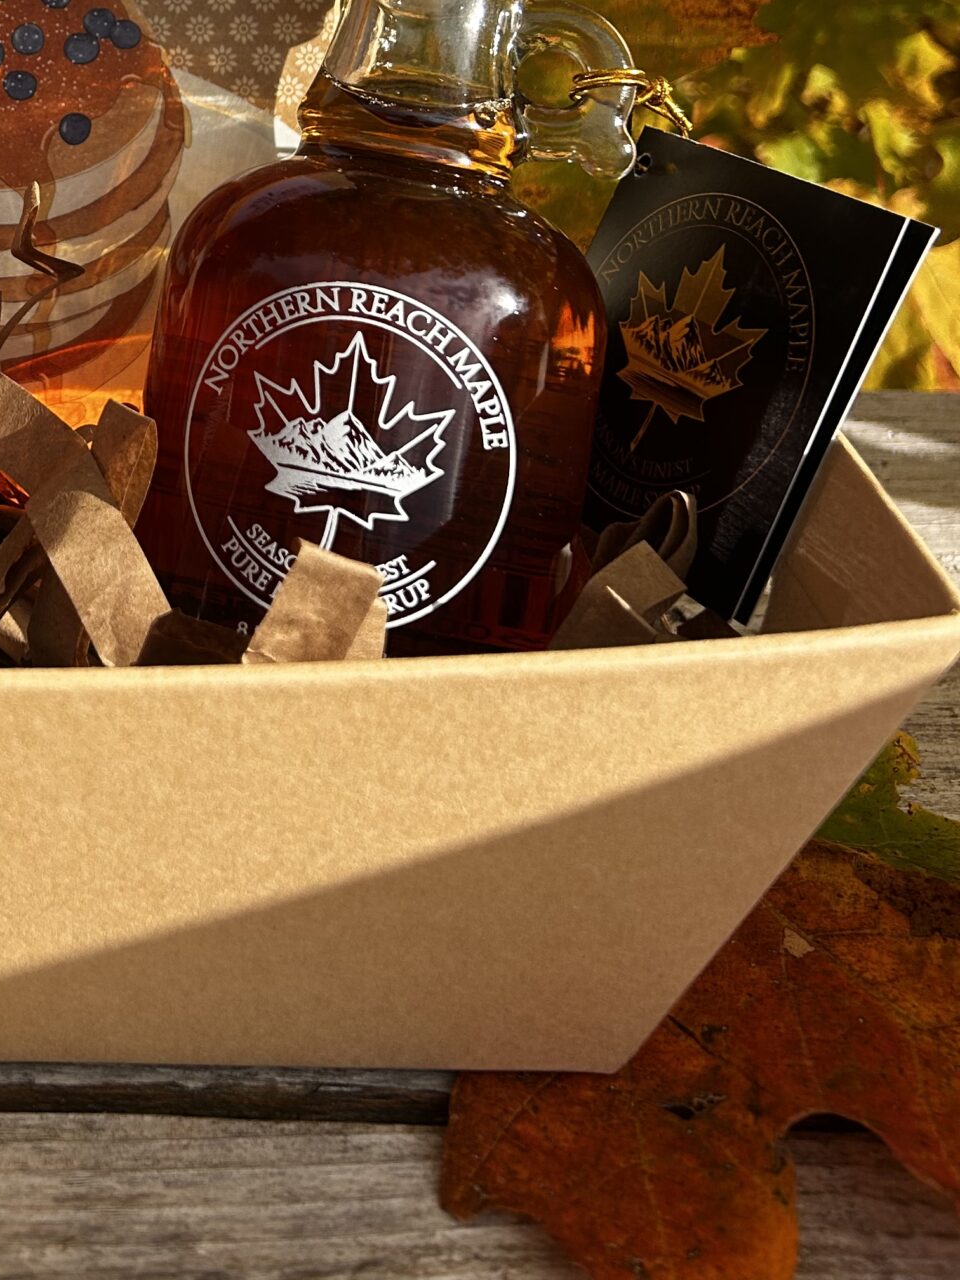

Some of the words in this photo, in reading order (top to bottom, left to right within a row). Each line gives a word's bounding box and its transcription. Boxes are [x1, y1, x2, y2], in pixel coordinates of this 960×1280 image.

[602, 198, 722, 284] NORTHERN
[726, 199, 794, 268] REACH
[783, 269, 809, 373] MAPLE
[204, 287, 340, 396] NORTHERN
[348, 288, 457, 354] REACH
[446, 347, 509, 450] MAPLE
[221, 536, 272, 591] PURE
[384, 579, 432, 614] RUP
